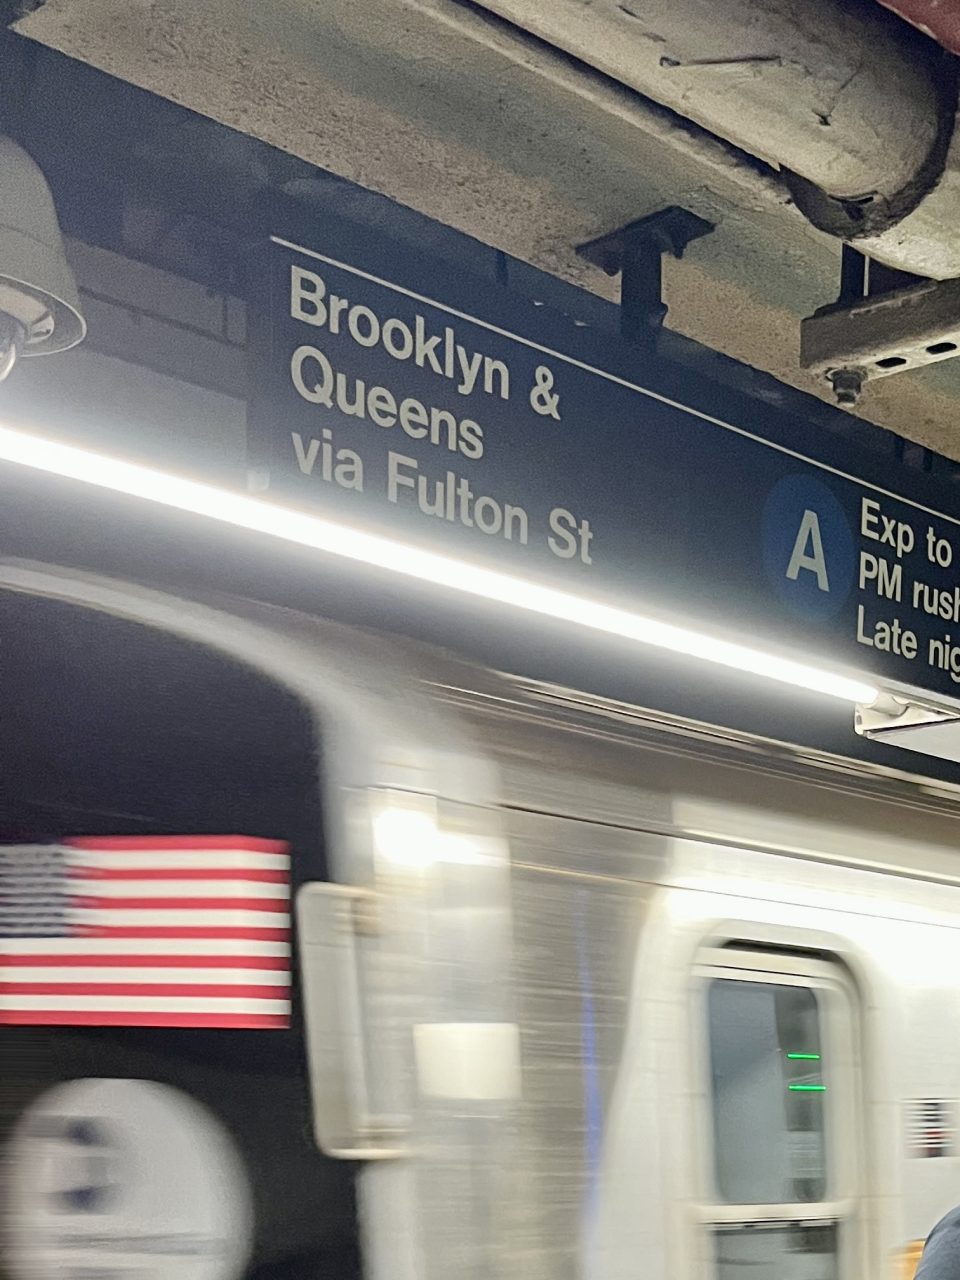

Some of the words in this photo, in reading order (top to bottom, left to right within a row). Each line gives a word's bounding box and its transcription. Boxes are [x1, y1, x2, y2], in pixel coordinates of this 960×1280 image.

[290, 265, 509, 400] Brooklyn
[529, 365, 561, 421] &
[290, 345, 484, 460] Queens
[291, 428, 364, 492] via
[387, 450, 528, 545] Fulton
[547, 507, 593, 565] St
[861, 497, 914, 558] Exp
[926, 527, 952, 568] to
[786, 509, 830, 593] A
[859, 551, 902, 602] PM
[857, 605, 917, 660] Late
